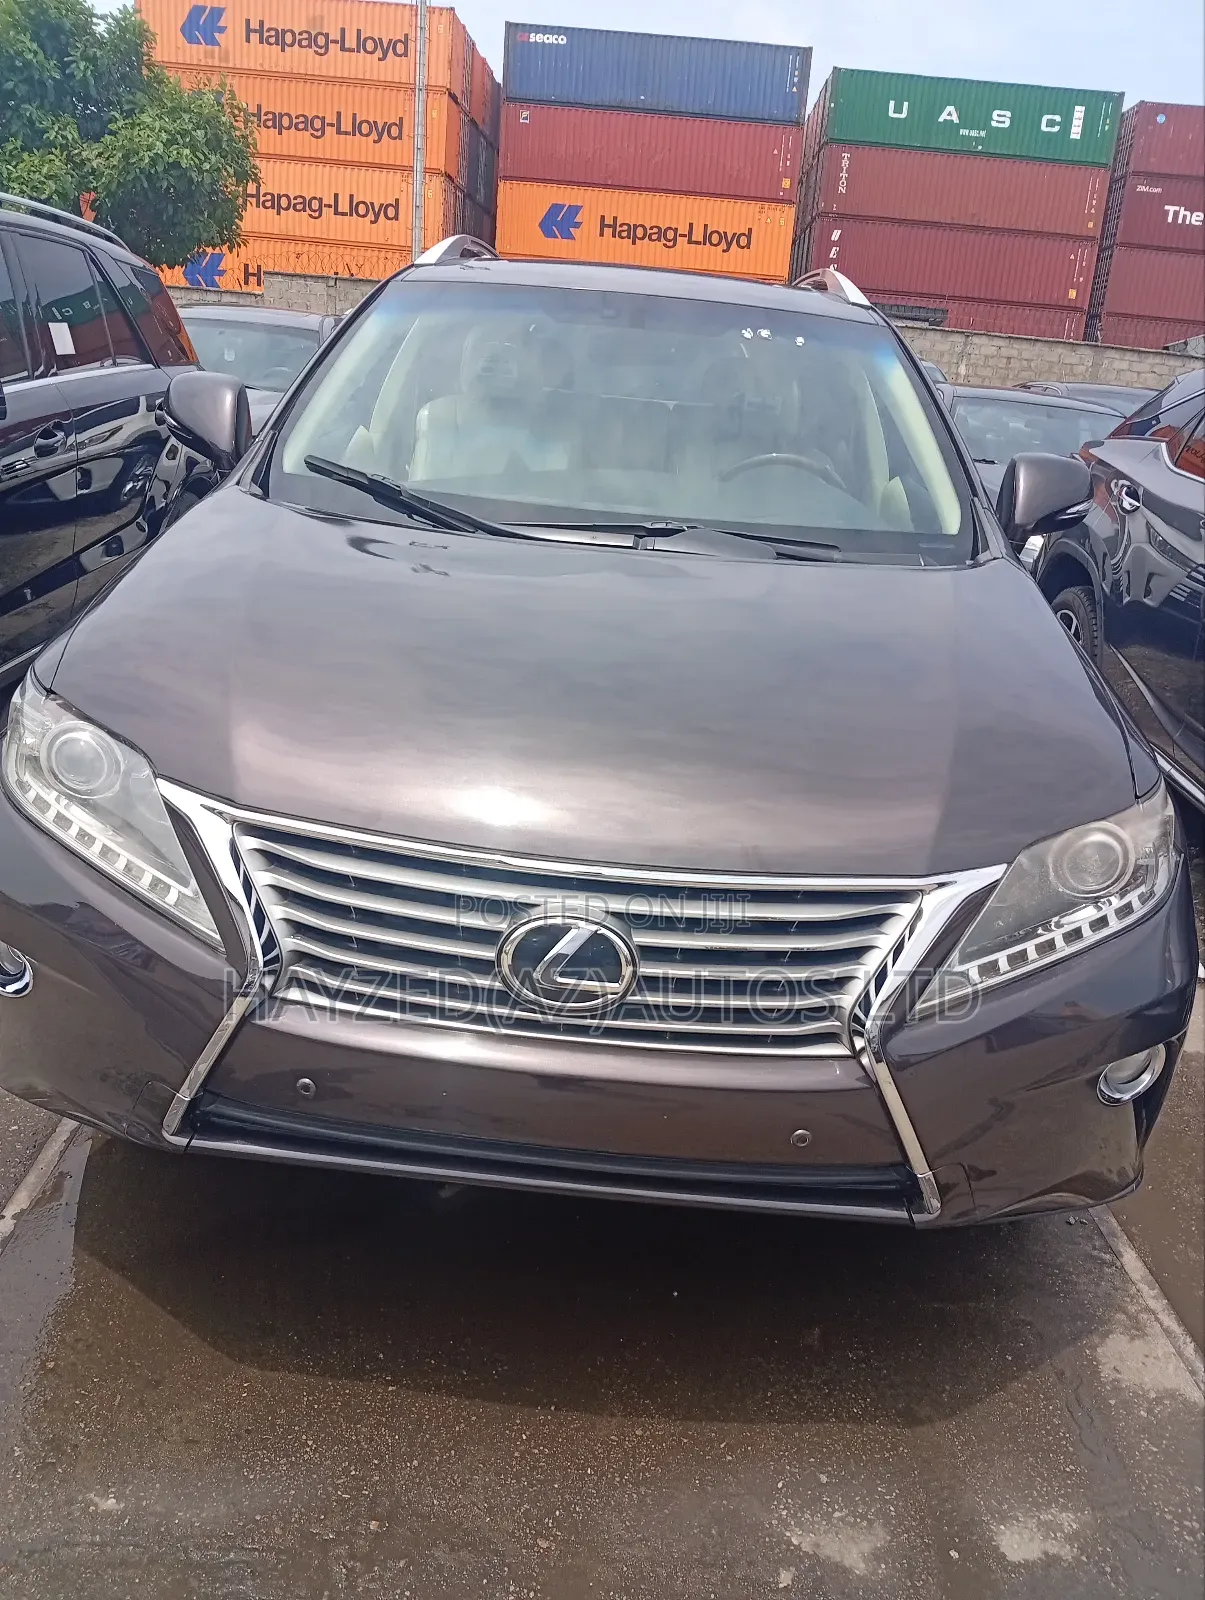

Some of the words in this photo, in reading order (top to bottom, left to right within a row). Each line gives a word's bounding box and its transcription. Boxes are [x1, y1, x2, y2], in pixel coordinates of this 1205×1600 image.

[245, 18, 409, 61] Hapag-Lloyd
[529, 32, 567, 45] seaco
[838, 152, 850, 194] TRITON
[245, 184, 400, 224] Hapag-Lloyd
[1164, 204, 1205, 226] The
[599, 214, 753, 253] Hapag-Lloyd
